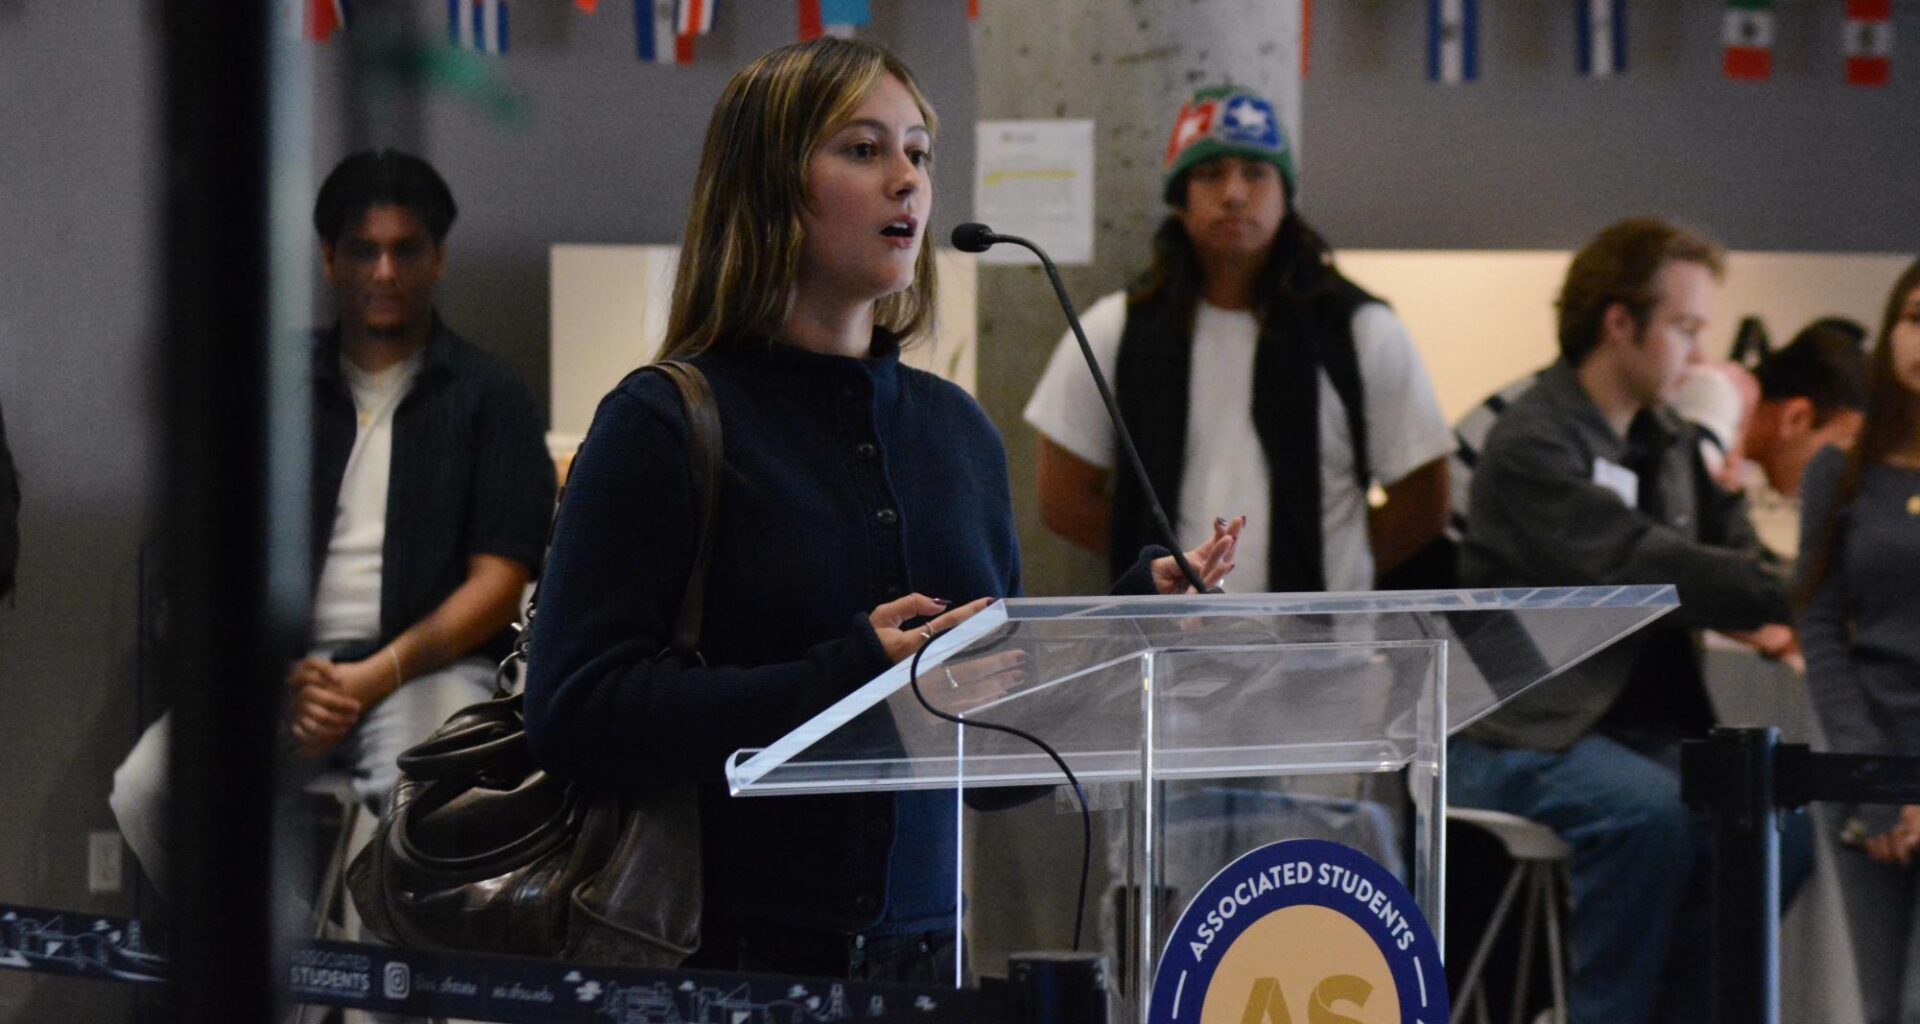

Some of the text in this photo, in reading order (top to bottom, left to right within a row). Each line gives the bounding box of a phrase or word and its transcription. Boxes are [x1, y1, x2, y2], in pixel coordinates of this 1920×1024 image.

[1189, 861, 1415, 962] ASSOCIATED STUDENTS
[290, 966, 371, 991] STUDENTS
